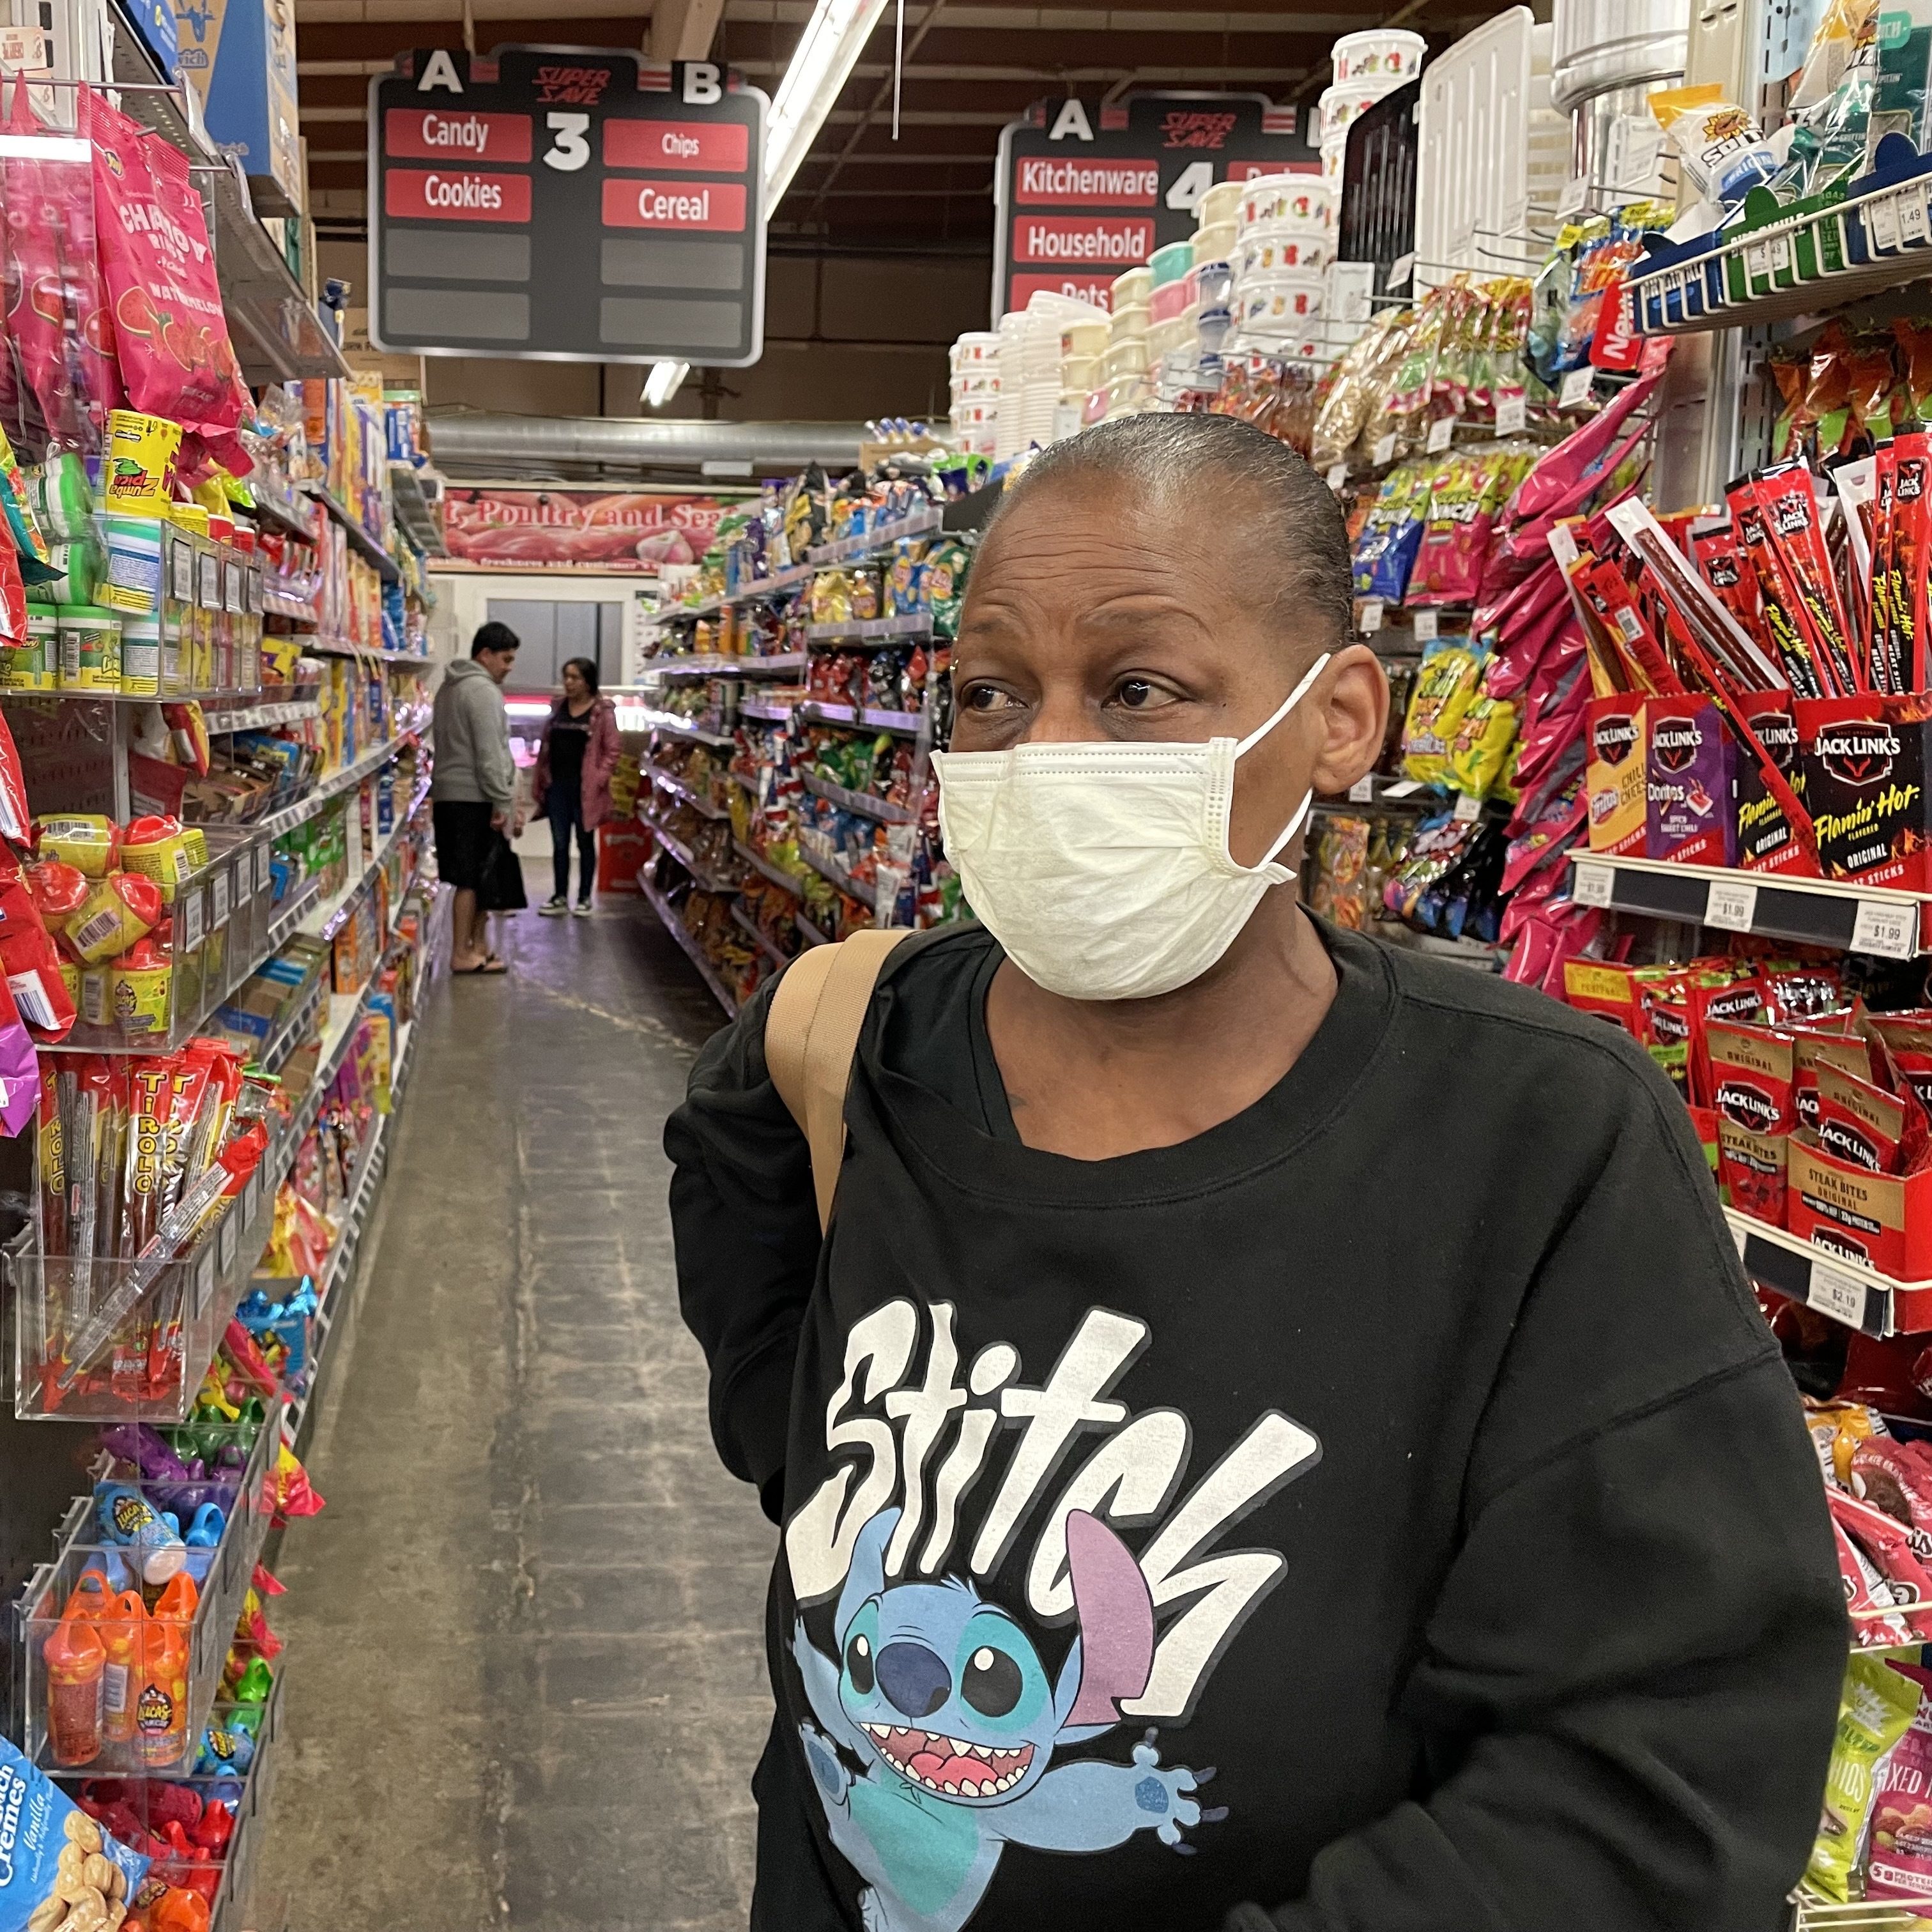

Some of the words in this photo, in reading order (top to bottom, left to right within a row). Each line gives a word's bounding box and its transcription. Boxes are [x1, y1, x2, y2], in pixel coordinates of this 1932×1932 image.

[417, 50, 464, 93] A
[531, 66, 611, 87] SUPER
[683, 63, 723, 105] B
[536, 85, 601, 105] SAVE
[422, 114, 489, 153] Candy
[1048, 98, 1094, 141] A
[542, 112, 591, 171] 3
[661, 133, 699, 158] Chips
[424, 175, 502, 210] Cookies
[1023, 161, 1159, 195] Kitchenware
[1165, 161, 1214, 218] 4
[638, 188, 709, 221] Cereal
[1027, 225, 1146, 259] Household
[109, 477, 160, 499] Zumba
[1898, 473, 1919, 489] JACK
[478, 500, 597, 533] Poultry
[605, 504, 663, 528] and
[1814, 737, 1854, 756] JACK
[1648, 783, 1685, 802] Doritos
[1876, 783, 1920, 817] Hot
[1756, 826, 1788, 854] ORIGINAL
[1768, 845, 1800, 869] STICKS
[1847, 843, 1888, 870] ORIGINAL
[1868, 864, 1905, 885] STICKS
[1706, 1000, 1735, 1018] JACK
[1715, 1087, 1749, 1109] JACK
[1818, 1123, 1853, 1151] JACK
[1809, 1167, 1838, 1193] STEAK
[1839, 1177, 1868, 1202] BITES
[1817, 1184, 1858, 1211] ORIGINAL
[785, 1300, 1319, 1717] Stitch
[23, 1793, 45, 1851] Vanilla
